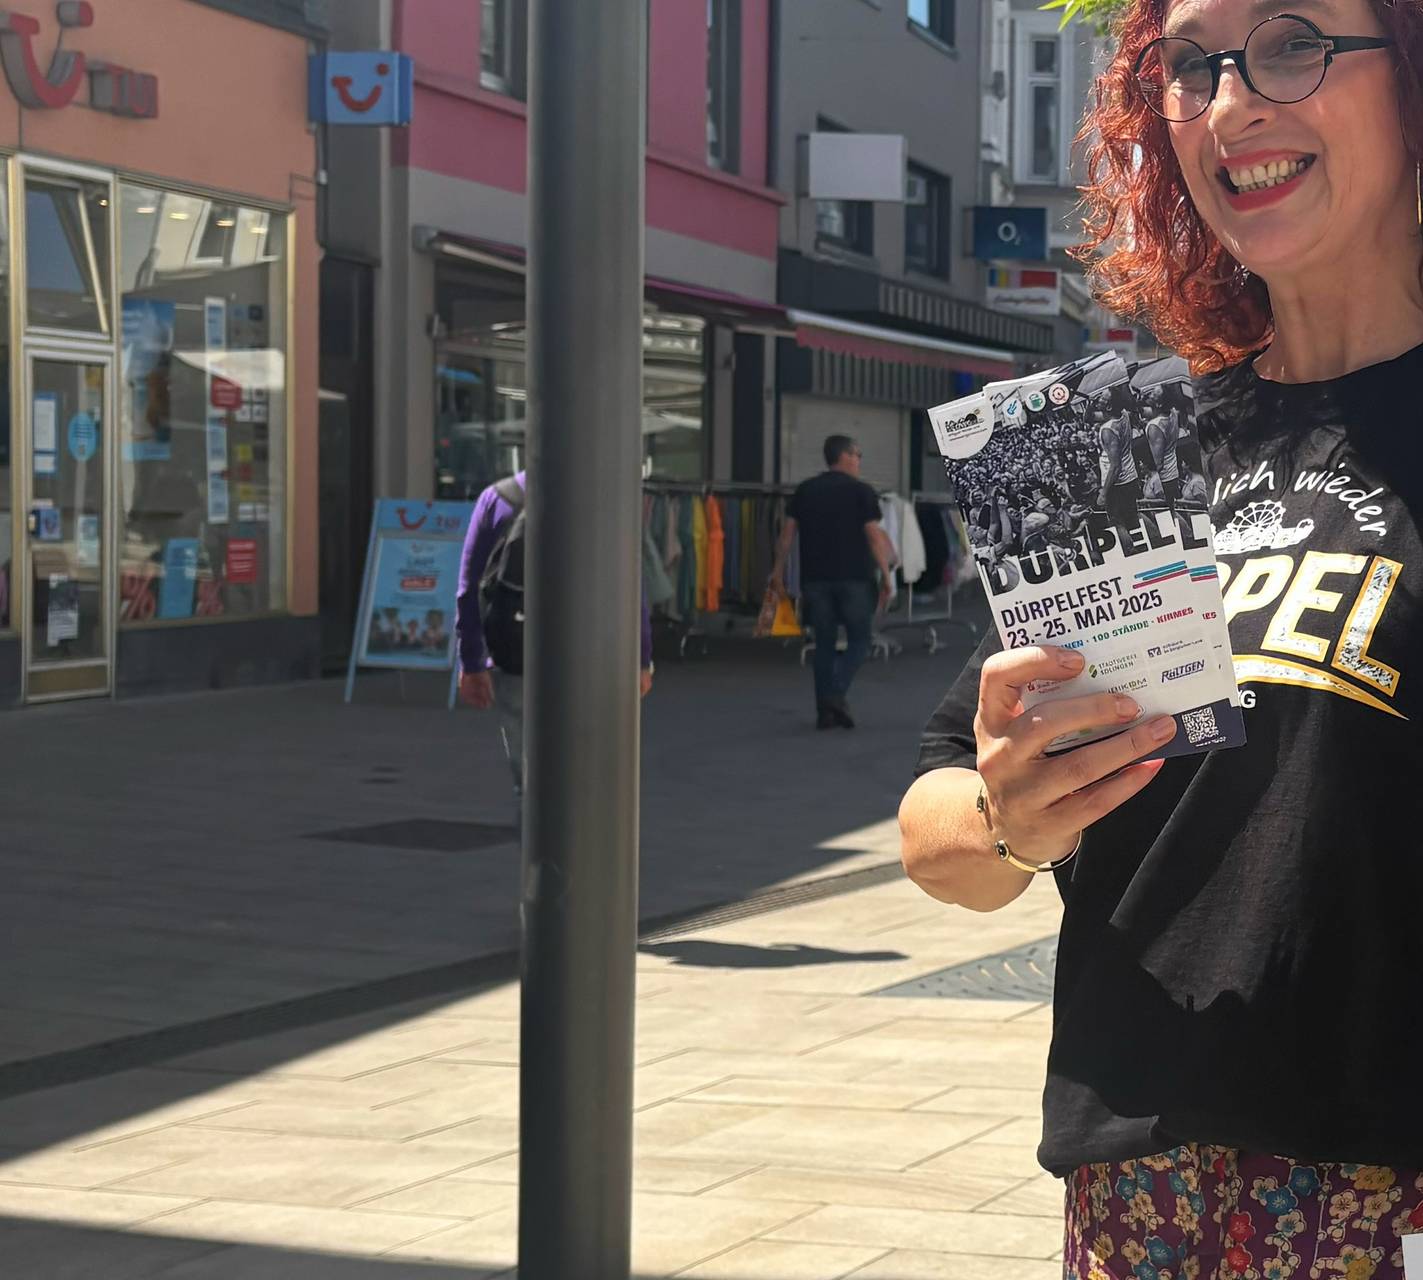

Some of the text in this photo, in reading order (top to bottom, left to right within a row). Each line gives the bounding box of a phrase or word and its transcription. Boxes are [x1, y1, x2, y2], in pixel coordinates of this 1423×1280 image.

[1212, 460, 1387, 537] lich wieder
[1001, 576, 1122, 628] DÜRPELFEST
[1073, 602, 1116, 630] MAI
[1119, 589, 1163, 617] 2025
[1092, 632, 1110, 643] 100
